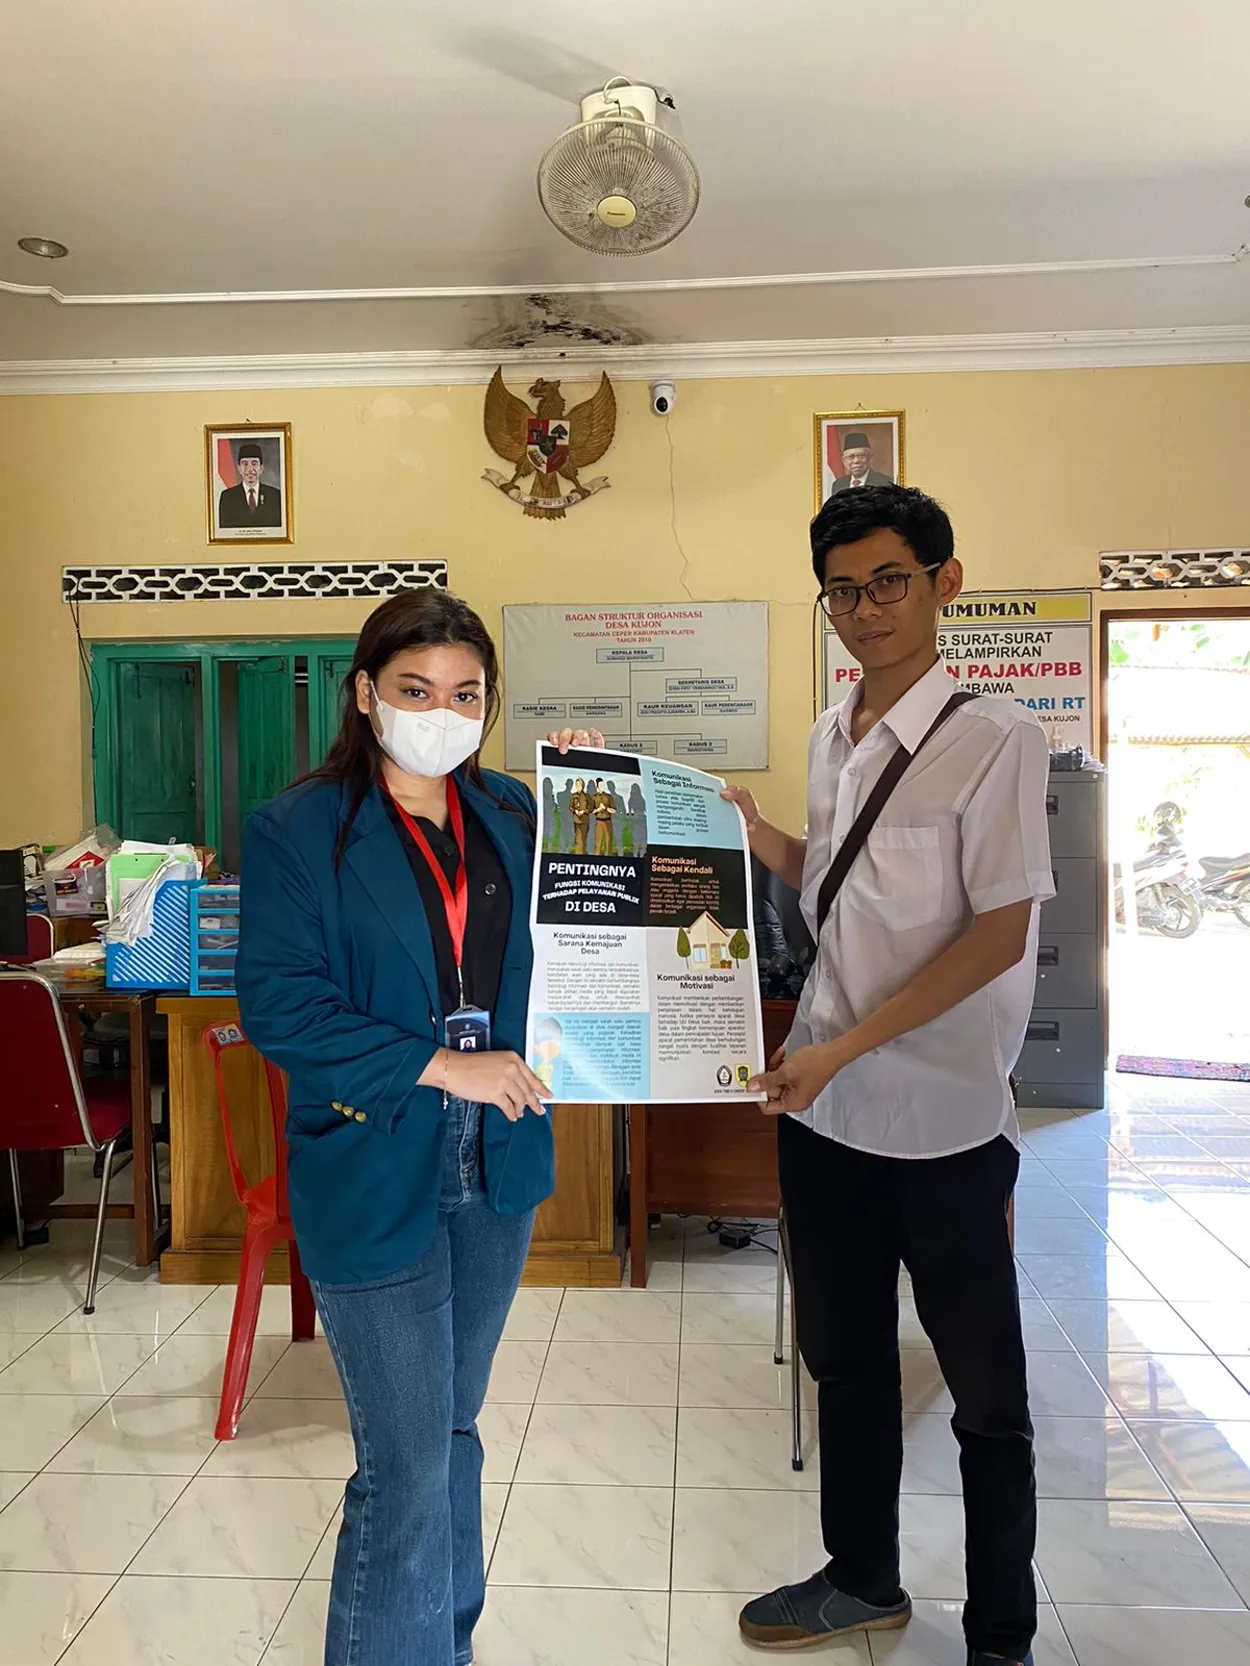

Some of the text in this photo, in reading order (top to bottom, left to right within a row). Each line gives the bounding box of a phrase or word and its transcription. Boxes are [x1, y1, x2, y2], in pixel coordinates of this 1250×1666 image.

[647, 611, 703, 619] ORGANISASI
[605, 621, 629, 629] DESA
[952, 632, 1053, 645] SURAT-SURAT
[968, 662, 1082, 678] PAJAK/PBB
[1062, 697, 1085, 709] RT
[651, 856, 697, 865] Komunikasi
[548, 862, 636, 878] PENTINGNYA
[651, 864, 713, 874] Sebagai Kendali
[554, 880, 625, 891] FUNGSI KOMUNIKASI
[542, 888, 640, 904] TERHADAP PELAYANAN PUBLIK
[565, 901, 616, 913] DI DESA
[553, 932, 627, 942] Komunikasi sebagai
[558, 940, 622, 949] Sarana Kemajuan
[657, 974, 735, 984] Komunikasi sebagai
[680, 982, 714, 990] Motivasi
